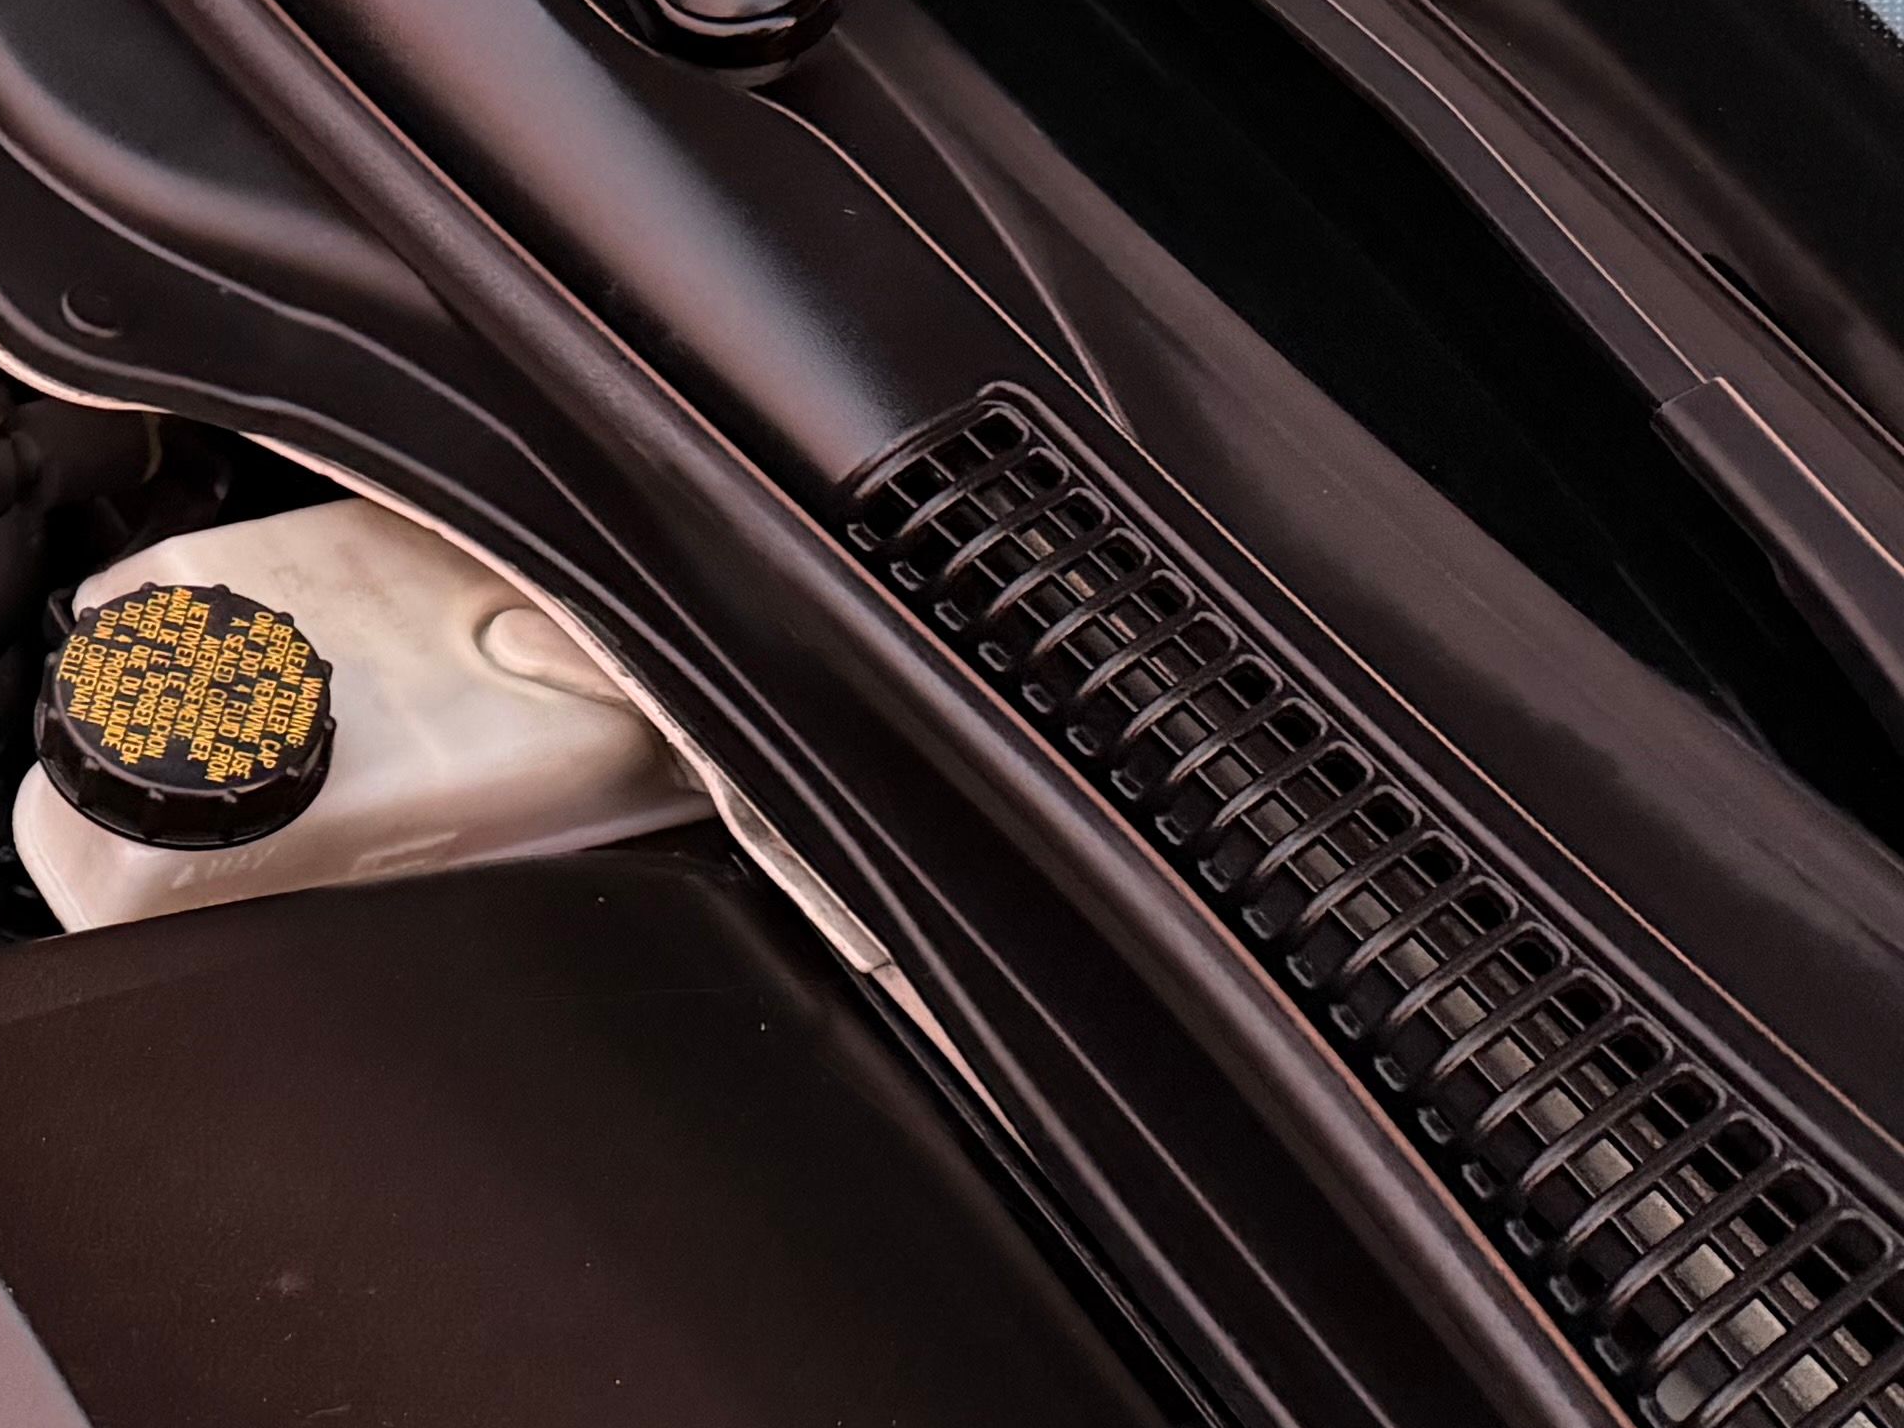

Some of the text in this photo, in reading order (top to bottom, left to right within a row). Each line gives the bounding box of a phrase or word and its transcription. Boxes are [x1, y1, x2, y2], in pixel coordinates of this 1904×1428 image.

[157, 628, 179, 647] DE
[165, 587, 193, 625] AVANT
[230, 617, 250, 628] A
[67, 644, 107, 720] CONTENANT
[86, 601, 144, 727] DOT 4 PROVENANT
[101, 591, 170, 750] PLOYER QUE DU LIQUIDE
[144, 602, 211, 759] NETTOYER LE BOUCHON
[150, 650, 172, 668] LE
[173, 634, 222, 740] AVERTISSEMENT:
[204, 611, 274, 783] ONLY DOT 4 FLUID FROM
[213, 633, 245, 683] SEALED
[229, 624, 293, 779] BEFORE REMOVING. USE
[256, 641, 310, 769] CLEAN FILLER CAP
[286, 677, 323, 748] WARNING:
